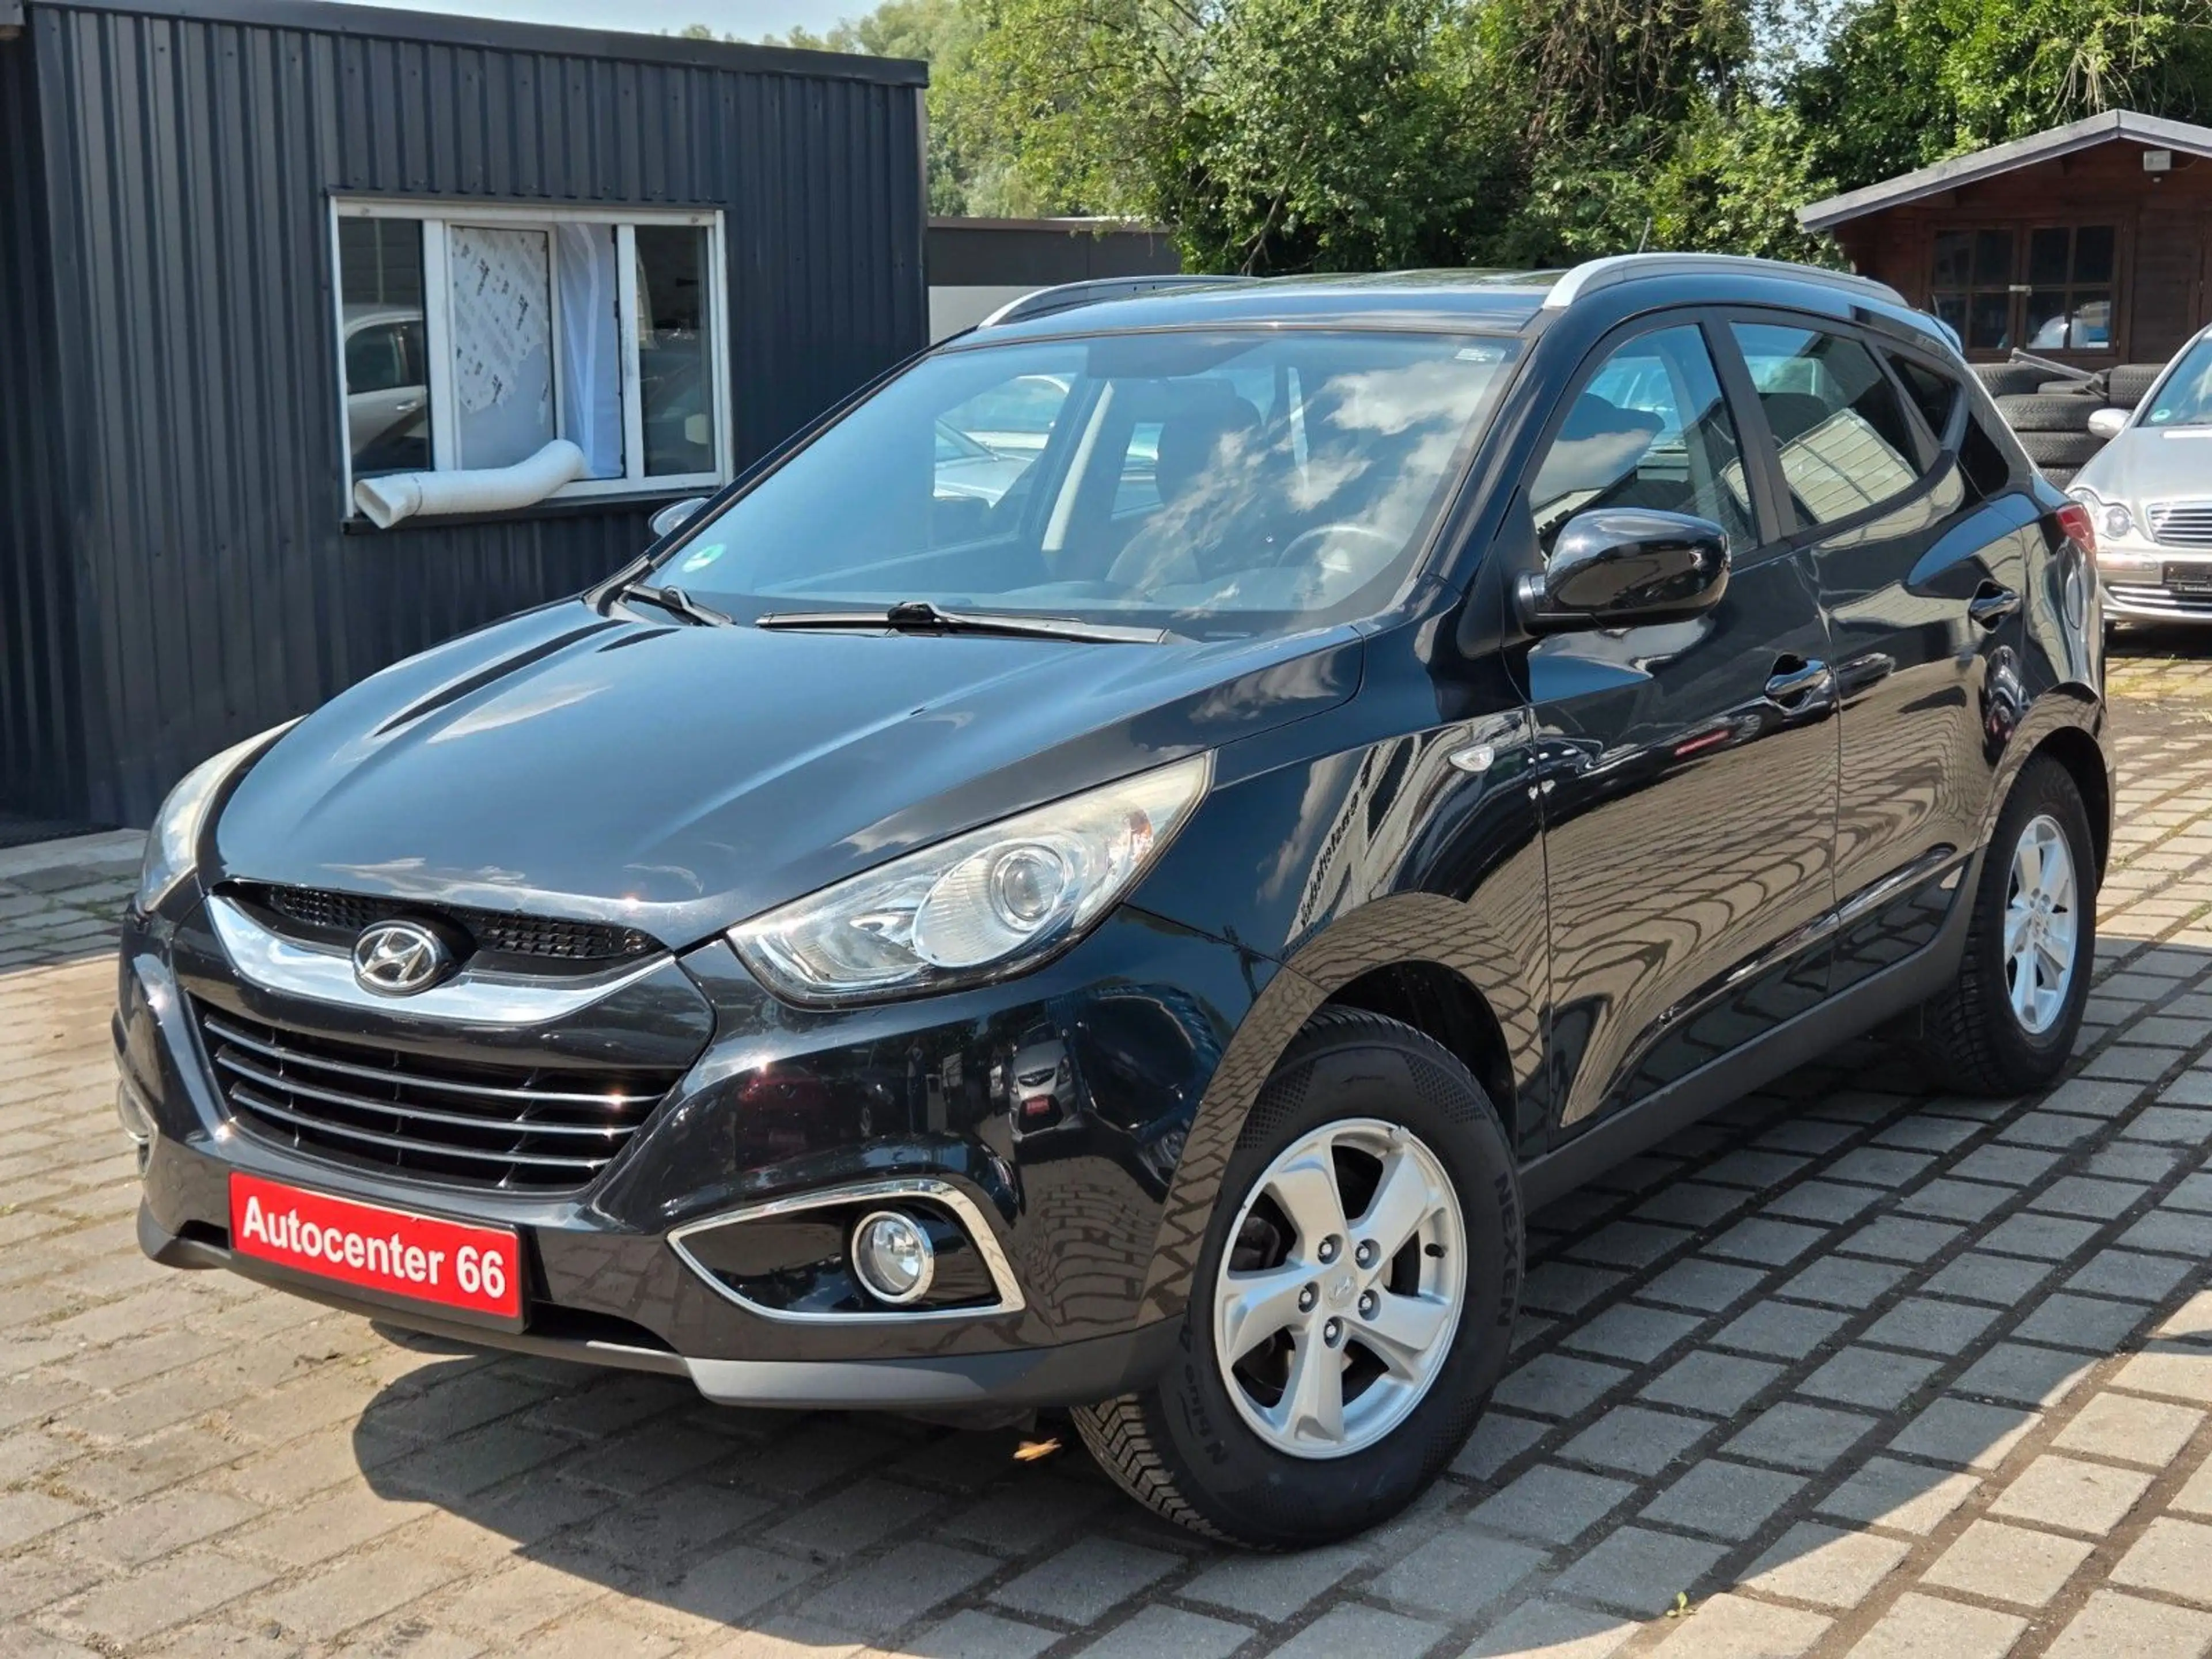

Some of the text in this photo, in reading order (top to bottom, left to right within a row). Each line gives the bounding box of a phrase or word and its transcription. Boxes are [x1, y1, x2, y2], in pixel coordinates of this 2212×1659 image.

[243, 1195, 506, 1298] Autocenter 66
[1494, 1171, 1518, 1327] NEXEN
